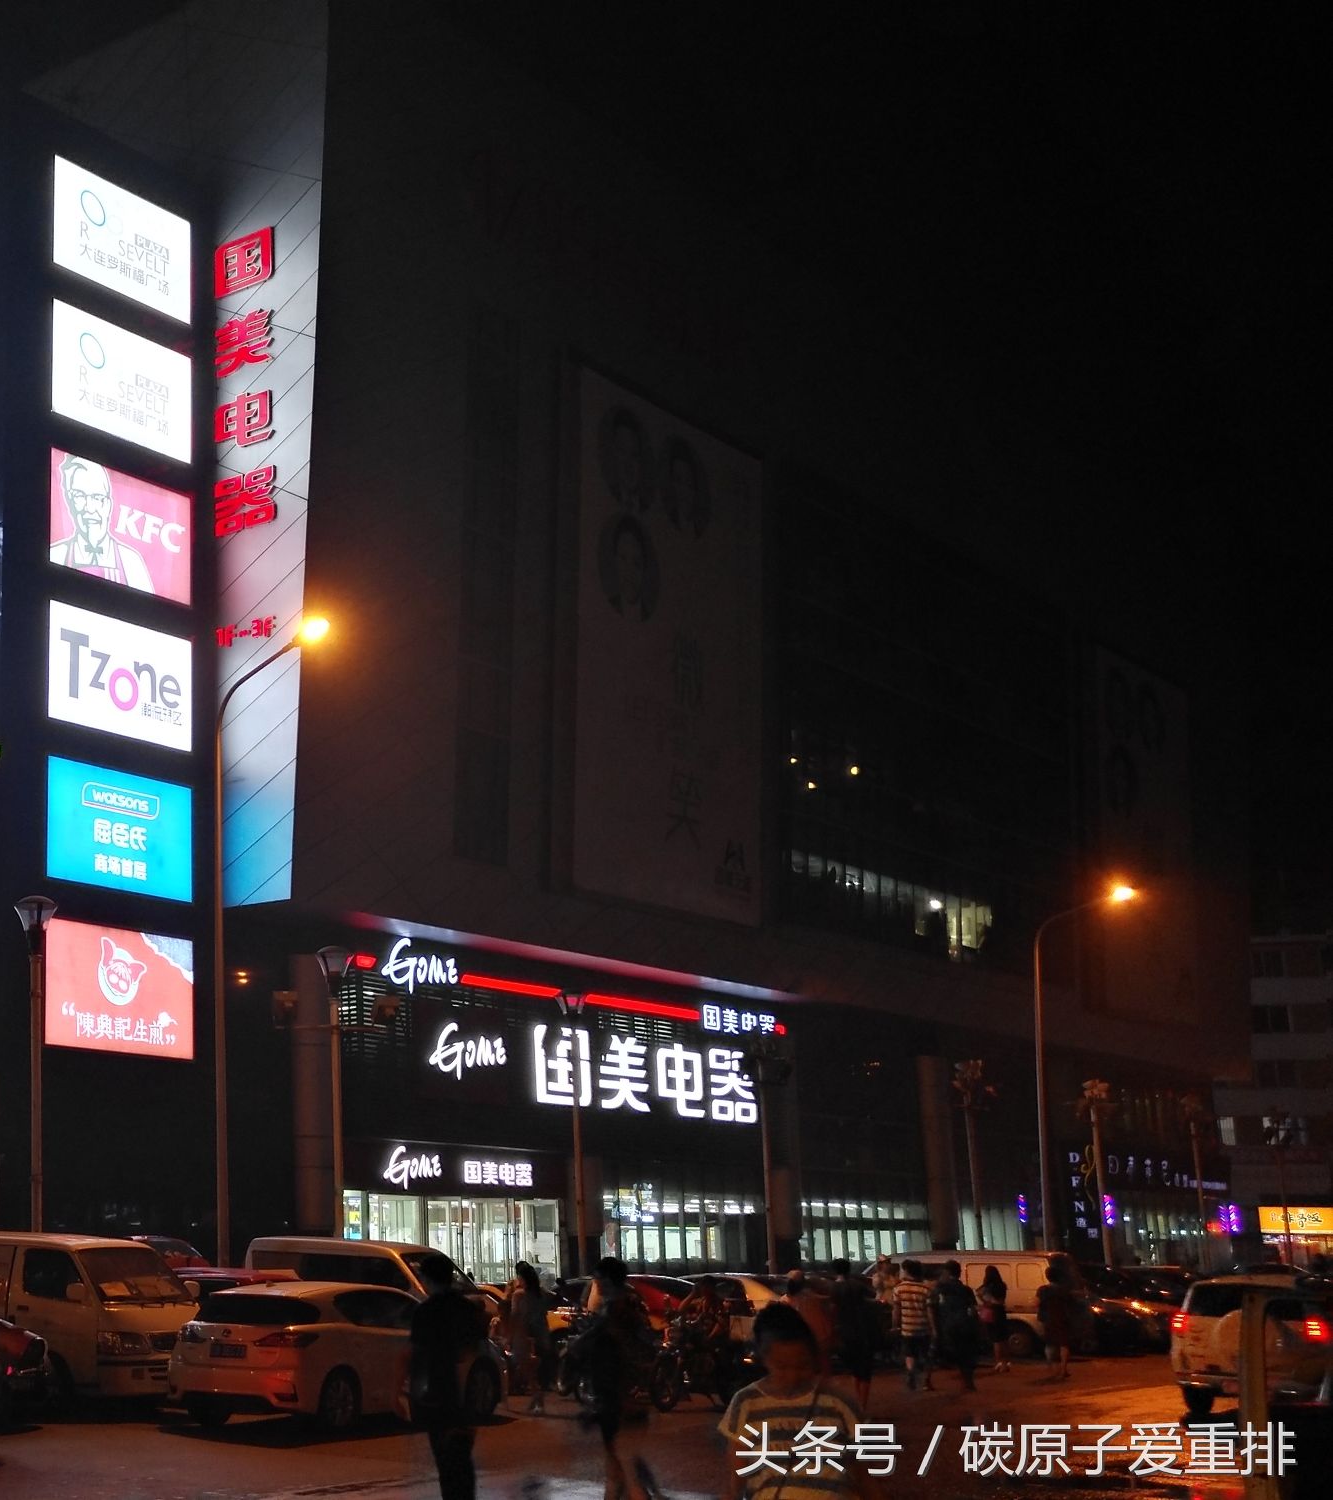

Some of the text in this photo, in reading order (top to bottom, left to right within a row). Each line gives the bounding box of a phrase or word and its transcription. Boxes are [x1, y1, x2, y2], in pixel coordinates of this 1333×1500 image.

[79, 243, 170, 296] 大连罗斯福广场
[214, 225, 276, 537] 国美电器
[78, 388, 169, 437] 大连罗斯福广场
[115, 505, 186, 554] KFC
[60, 627, 182, 712] Tzone
[92, 788, 150, 813] watsons
[93, 817, 147, 851] 屈臣氏
[94, 853, 147, 881] 商场首层
[534, 1024, 758, 1124] 国美电器
[464, 1161, 533, 1187] 国美电器
